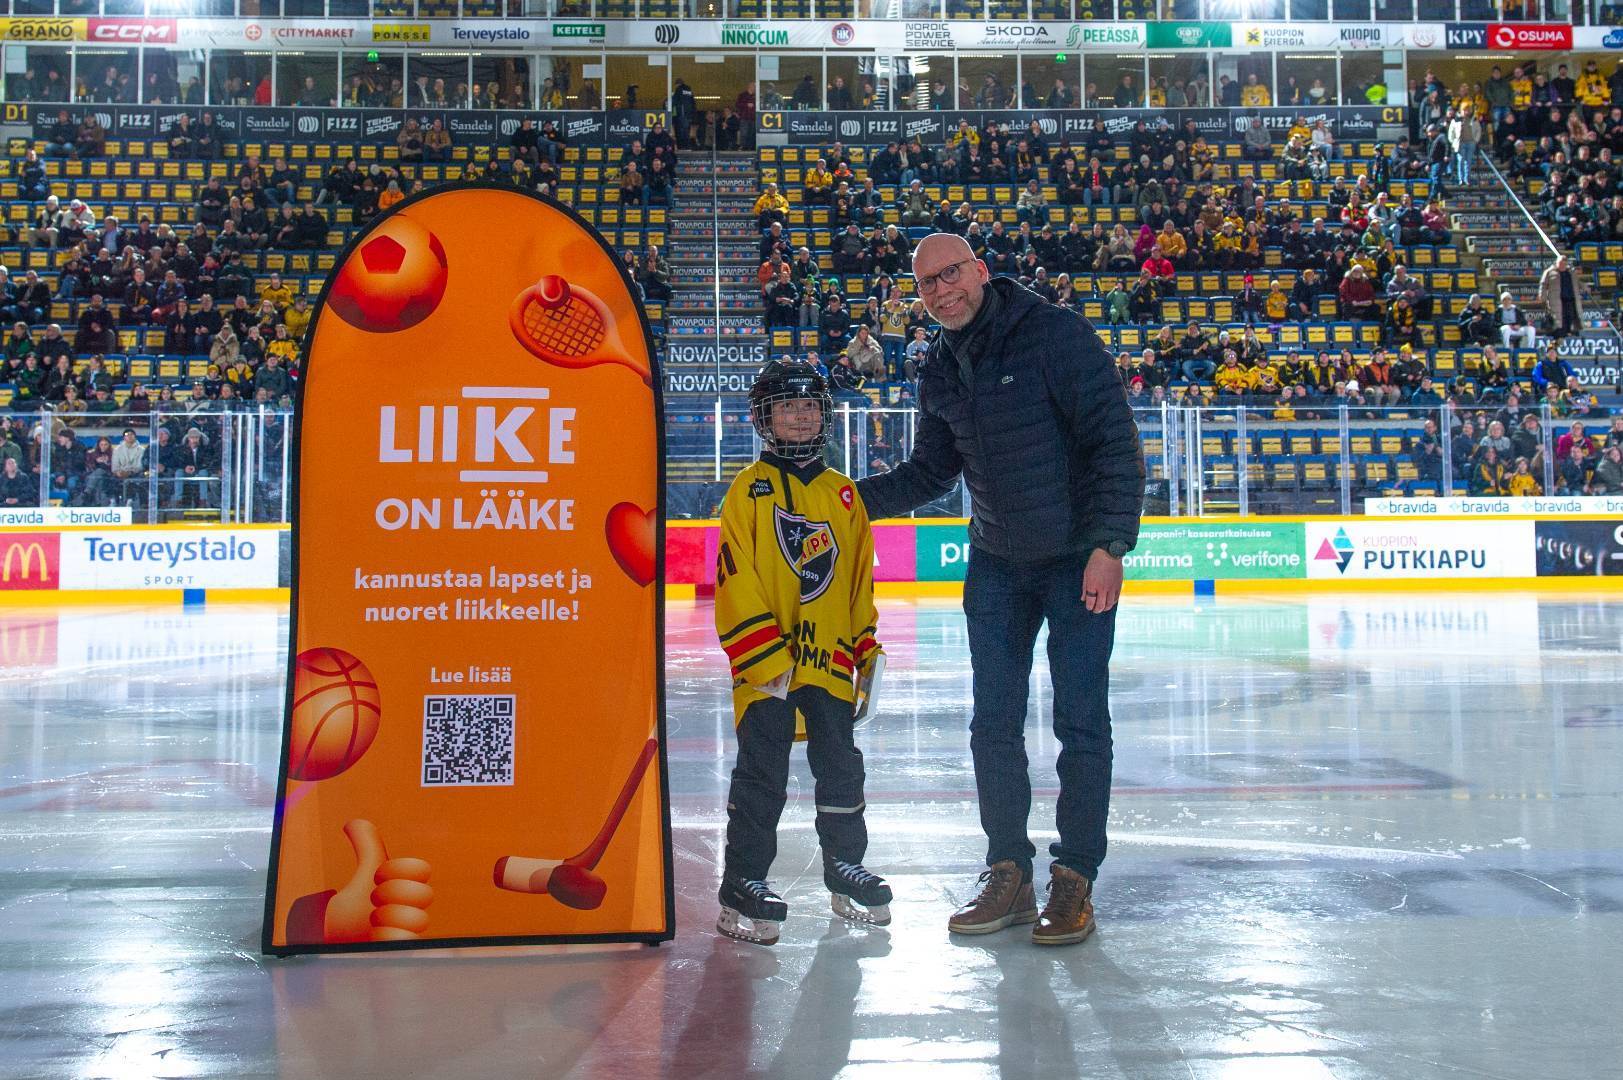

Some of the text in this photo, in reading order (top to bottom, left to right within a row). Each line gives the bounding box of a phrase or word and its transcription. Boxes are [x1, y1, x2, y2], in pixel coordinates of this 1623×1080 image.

[10, 25, 73, 38] GRANO
[95, 25, 170, 38] CCM
[556, 26, 602, 35] KEITELE
[905, 23, 949, 31] NORDIC
[1264, 29, 1304, 37] KUOPION
[373, 31, 429, 39] PONSSE
[451, 27, 530, 42] Terveystalo
[721, 30, 789, 45] INNOCUM
[905, 31, 951, 39] POWER
[1083, 27, 1140, 43] PEEÄSSÄ
[1340, 28, 1381, 41] KUOPIO
[1448, 30, 1485, 44] KPY
[1518, 30, 1565, 41] OSUMA
[905, 39, 955, 47] SERVICE
[6, 104, 27, 121] D1
[1382, 107, 1403, 122] C1
[119, 114, 151, 127] FIZZ
[247, 116, 290, 128] Sandels
[327, 117, 357, 130] FIZZ
[450, 119, 493, 131] Sandels
[645, 112, 666, 128] D1
[762, 113, 782, 128] C1
[791, 120, 833, 132] Sandels
[868, 121, 897, 132] FIZZ
[1065, 119, 1094, 132] FIZZ
[1263, 117, 1293, 128] FIZZ
[672, 318, 760, 326] NOVAPOLIS NOVAPOLIS
[670, 346, 764, 362] NOVAPOLIS
[379, 405, 577, 464] LIIKE
[375, 489, 575, 531] ON LÄÄKE
[1389, 500, 1437, 513] bravida
[1462, 500, 1510, 513] bravida
[1534, 499, 1582, 512] bravida
[0, 510, 121, 524] ravida bravida
[1362, 535, 1418, 547] KUOPION
[84, 535, 256, 568] Terveystalo
[1231, 550, 1300, 567] verifone
[1364, 549, 1486, 569] PUTKIAPU
[144, 575, 194, 585] SPORT
[354, 566, 592, 594] kannustaa lapset ja
[365, 598, 579, 621] nuoret liikkeelle!
[430, 666, 512, 683] Lue lisää
